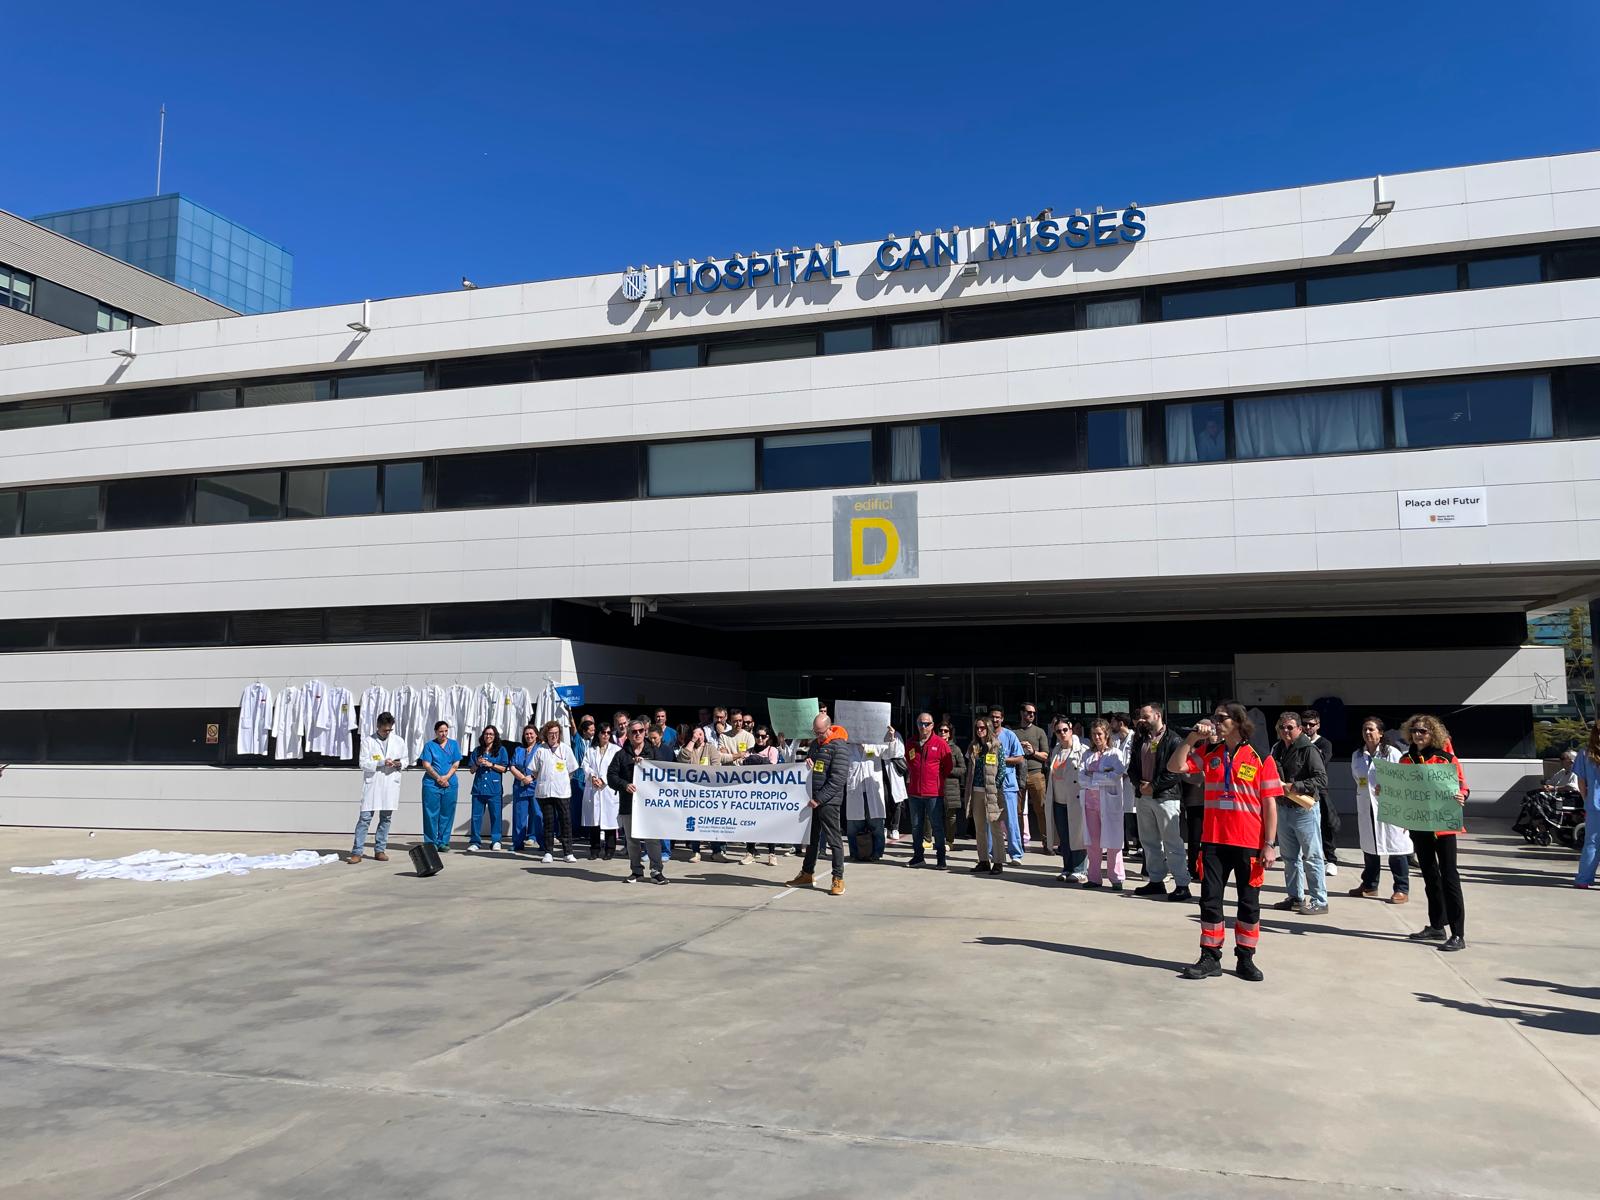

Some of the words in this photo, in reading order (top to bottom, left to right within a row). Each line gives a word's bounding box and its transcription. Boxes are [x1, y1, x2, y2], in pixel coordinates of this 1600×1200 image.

[669, 248, 851, 297] HOSPITAL
[876, 233, 958, 272] CAN
[987, 208, 1147, 260] MISSES
[854, 497, 893, 511] edifici
[1405, 499, 1432, 508] Plaça
[1434, 498, 1450, 506] del
[1453, 497, 1480, 505] Futur
[850, 517, 901, 576] D
[642, 768, 711, 783] HUELGA
[715, 770, 806, 785] NACIONAL
[1427, 769, 1458, 782] PARAR
[659, 788, 679, 798] POR
[682, 789, 696, 798] UN
[699, 789, 748, 799] ESTATUTO
[750, 790, 788, 800] PROPIO
[1404, 788, 1431, 801] PUEDE
[645, 799, 671, 808] PARA
[674, 798, 719, 809] MÉDICOS
[721, 800, 728, 809] Y
[730, 801, 800, 811] FACULTATIVOS
[1381, 802, 1401, 816] STOP
[697, 816, 738, 826] SIMEBAL
